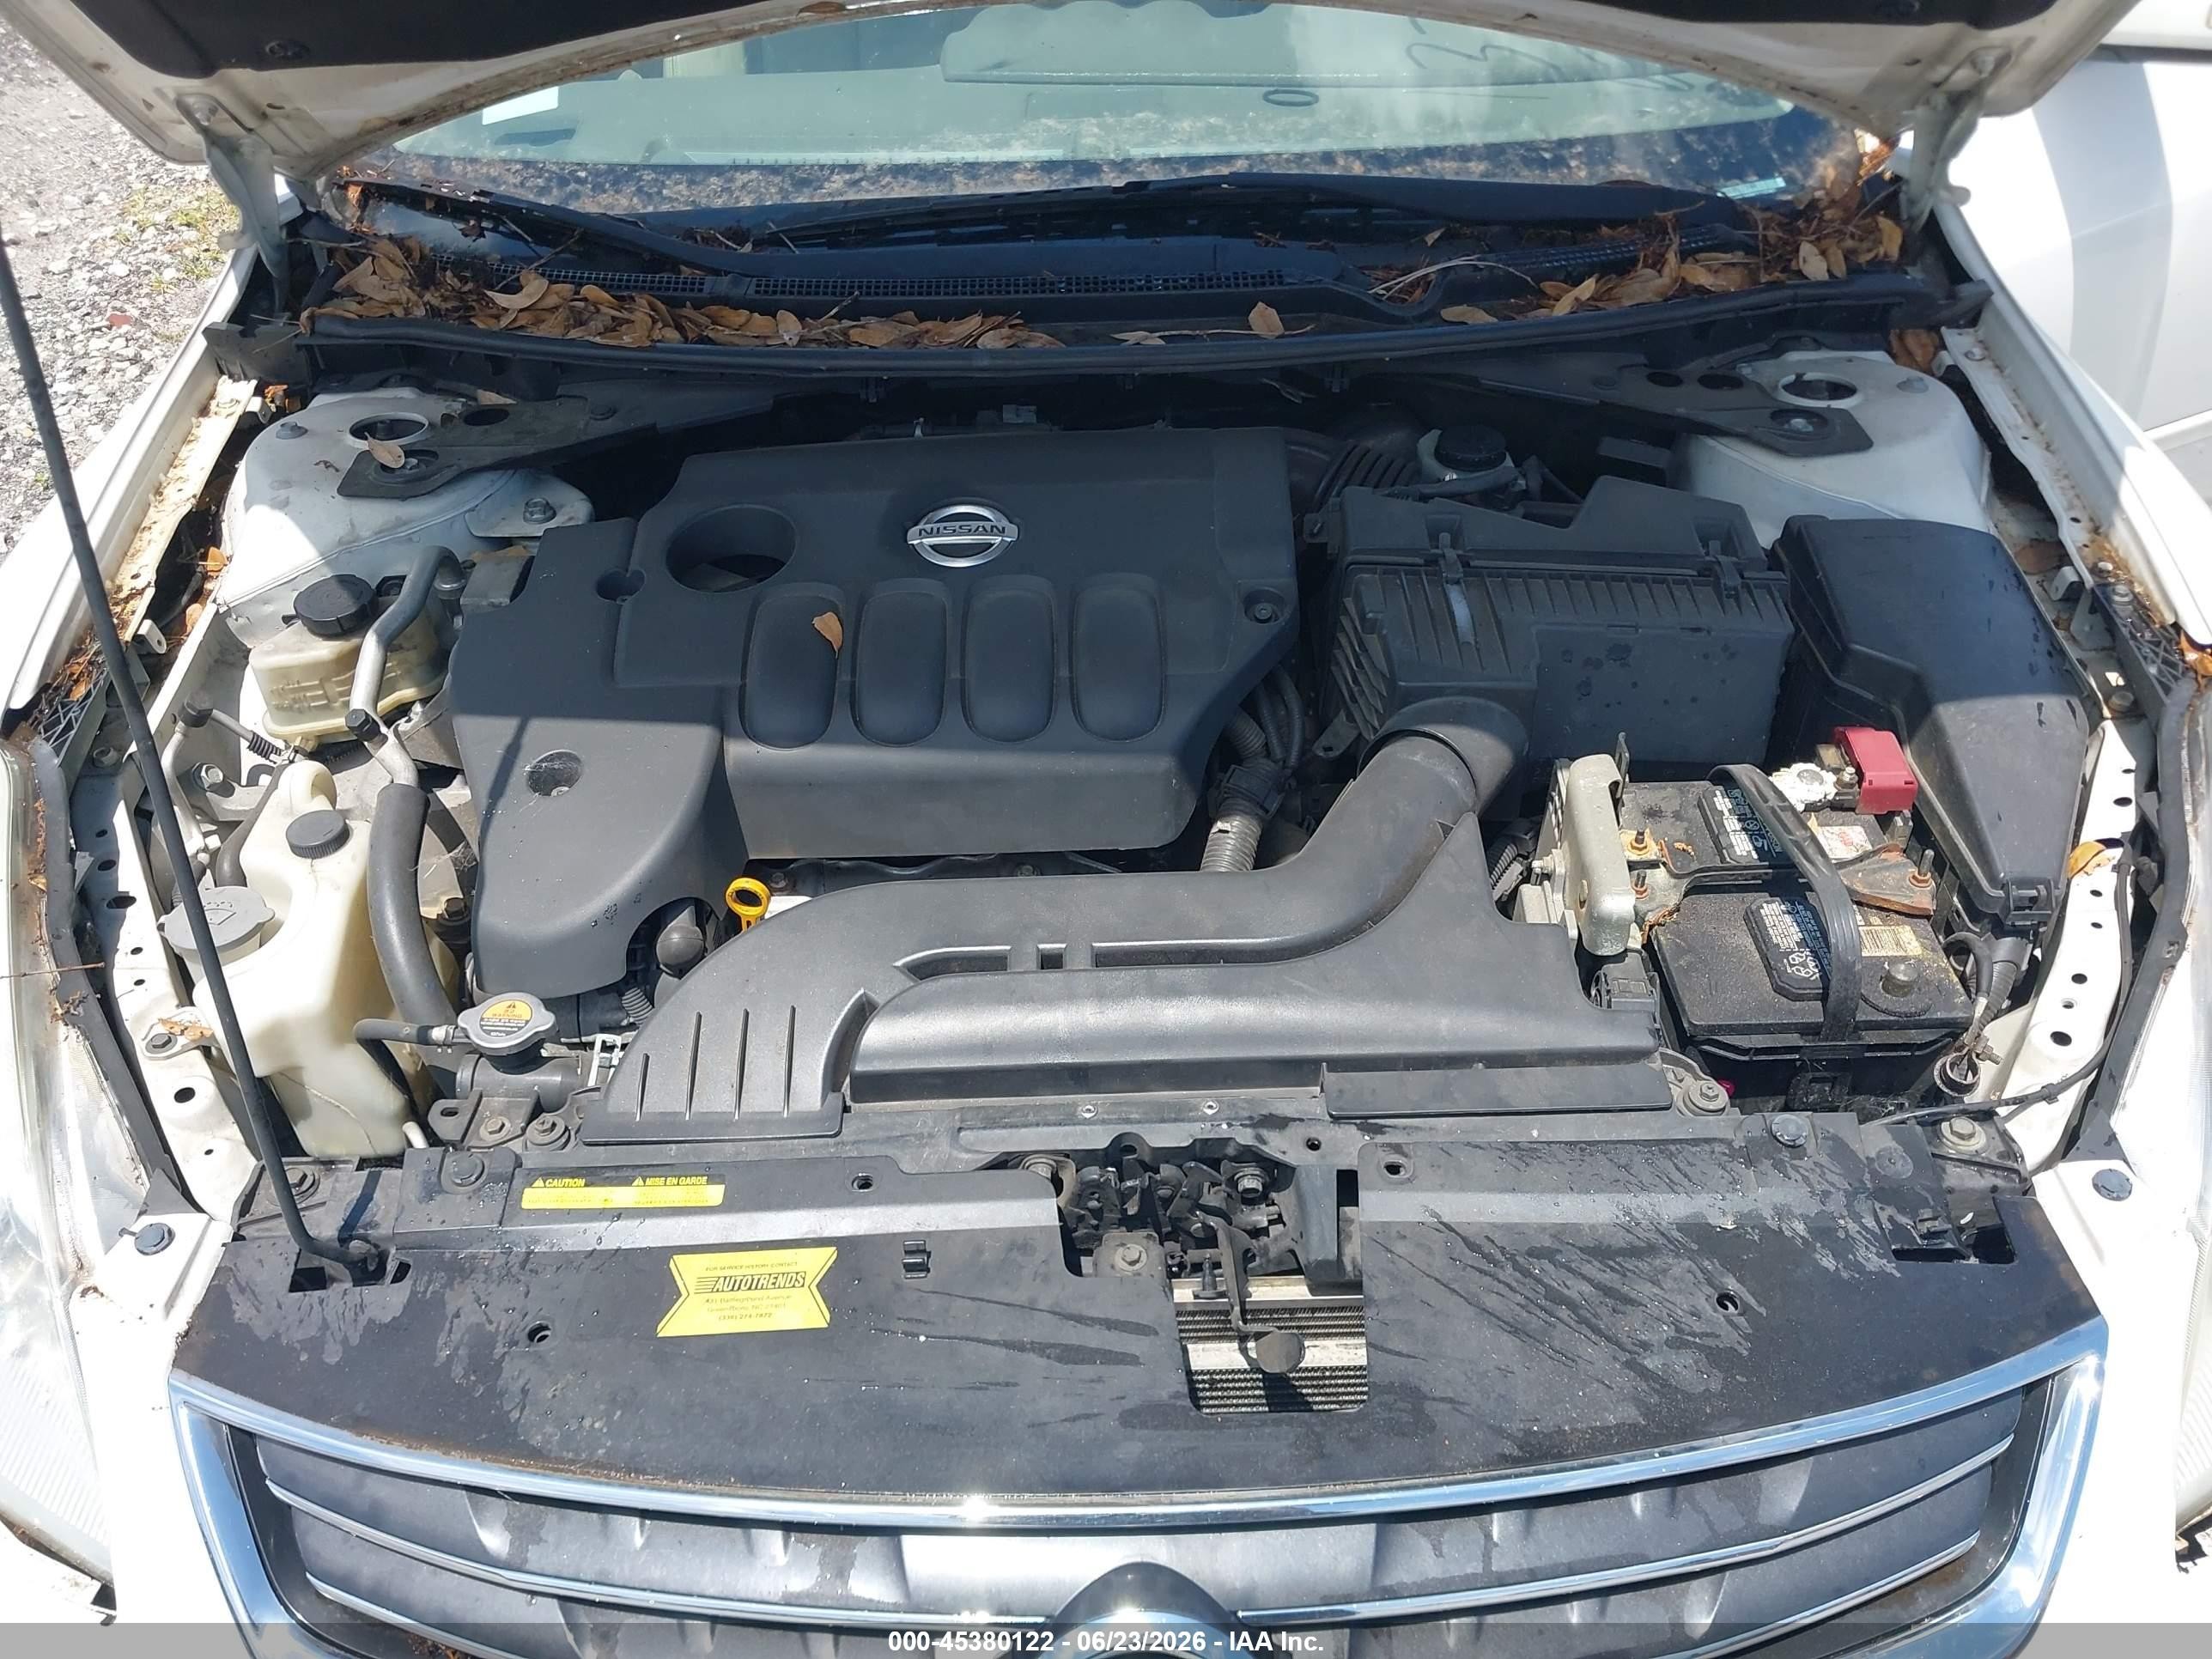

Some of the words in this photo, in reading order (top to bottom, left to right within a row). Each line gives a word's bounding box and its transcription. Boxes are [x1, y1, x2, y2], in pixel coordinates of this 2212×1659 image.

[918, 525, 1006, 537] NISSAN
[544, 1178, 586, 1188] CAUTION
[645, 1176, 665, 1186] MISE
[666, 1176, 678, 1185] EN
[679, 1176, 708, 1185] GARDE
[713, 1271, 805, 1292] AUTOTRENDS
